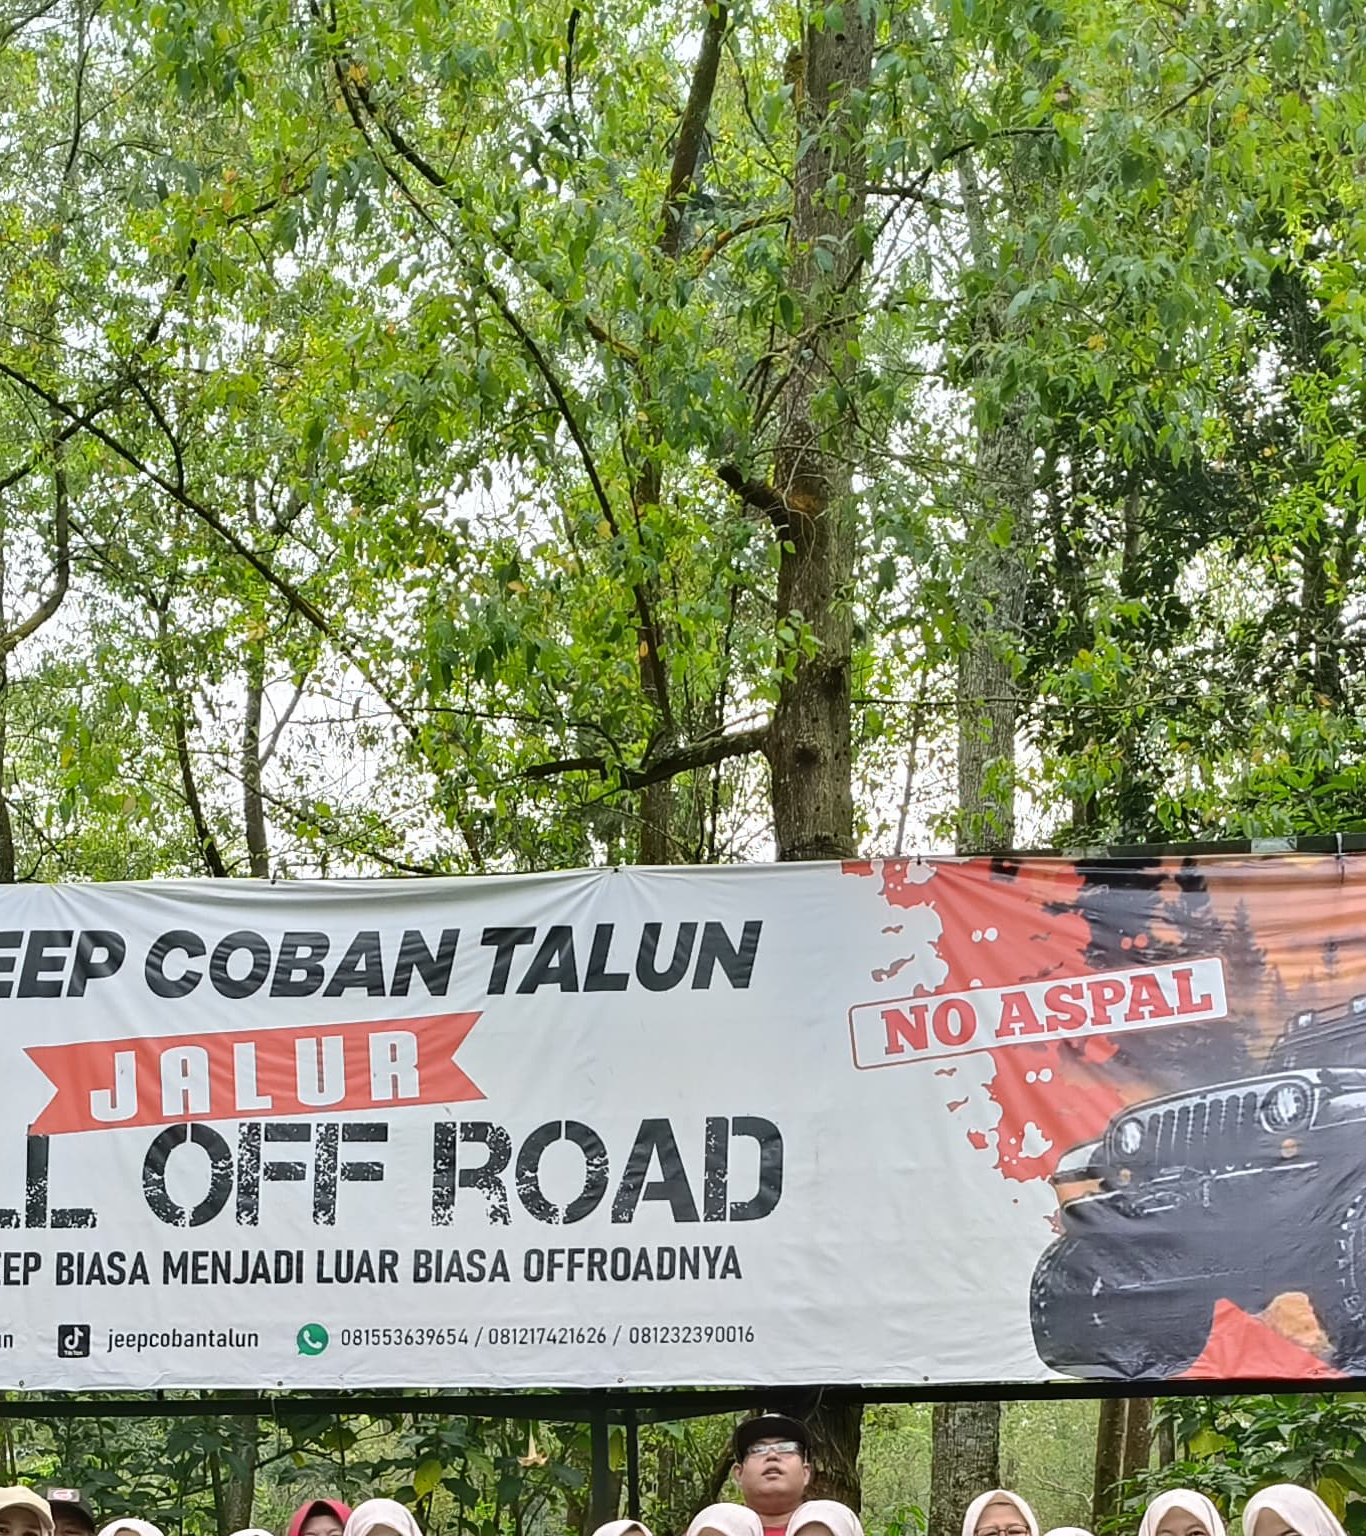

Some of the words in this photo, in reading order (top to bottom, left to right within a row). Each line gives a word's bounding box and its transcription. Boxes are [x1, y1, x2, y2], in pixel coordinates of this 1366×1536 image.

[145, 928, 459, 999] COBAN
[481, 920, 763, 994] TALUN
[881, 999, 977, 1055] NO
[995, 968, 1213, 1038] ASPAL
[90, 1031, 421, 1122] JALUR
[142, 1122, 389, 1227] OFF
[431, 1116, 784, 1226] ROAD
[55, 1250, 151, 1285] BIASA
[162, 1249, 305, 1285] MENJADI
[316, 1249, 400, 1284] LUAR
[413, 1248, 511, 1283] BIASA
[524, 1245, 742, 1282] OFFROADNYA
[107, 1327, 259, 1352] jeepcobantalun
[340, 1327, 469, 1347] 081553639654
[488, 1326, 607, 1346] 081217421626
[629, 1325, 754, 1345] 081232390016
